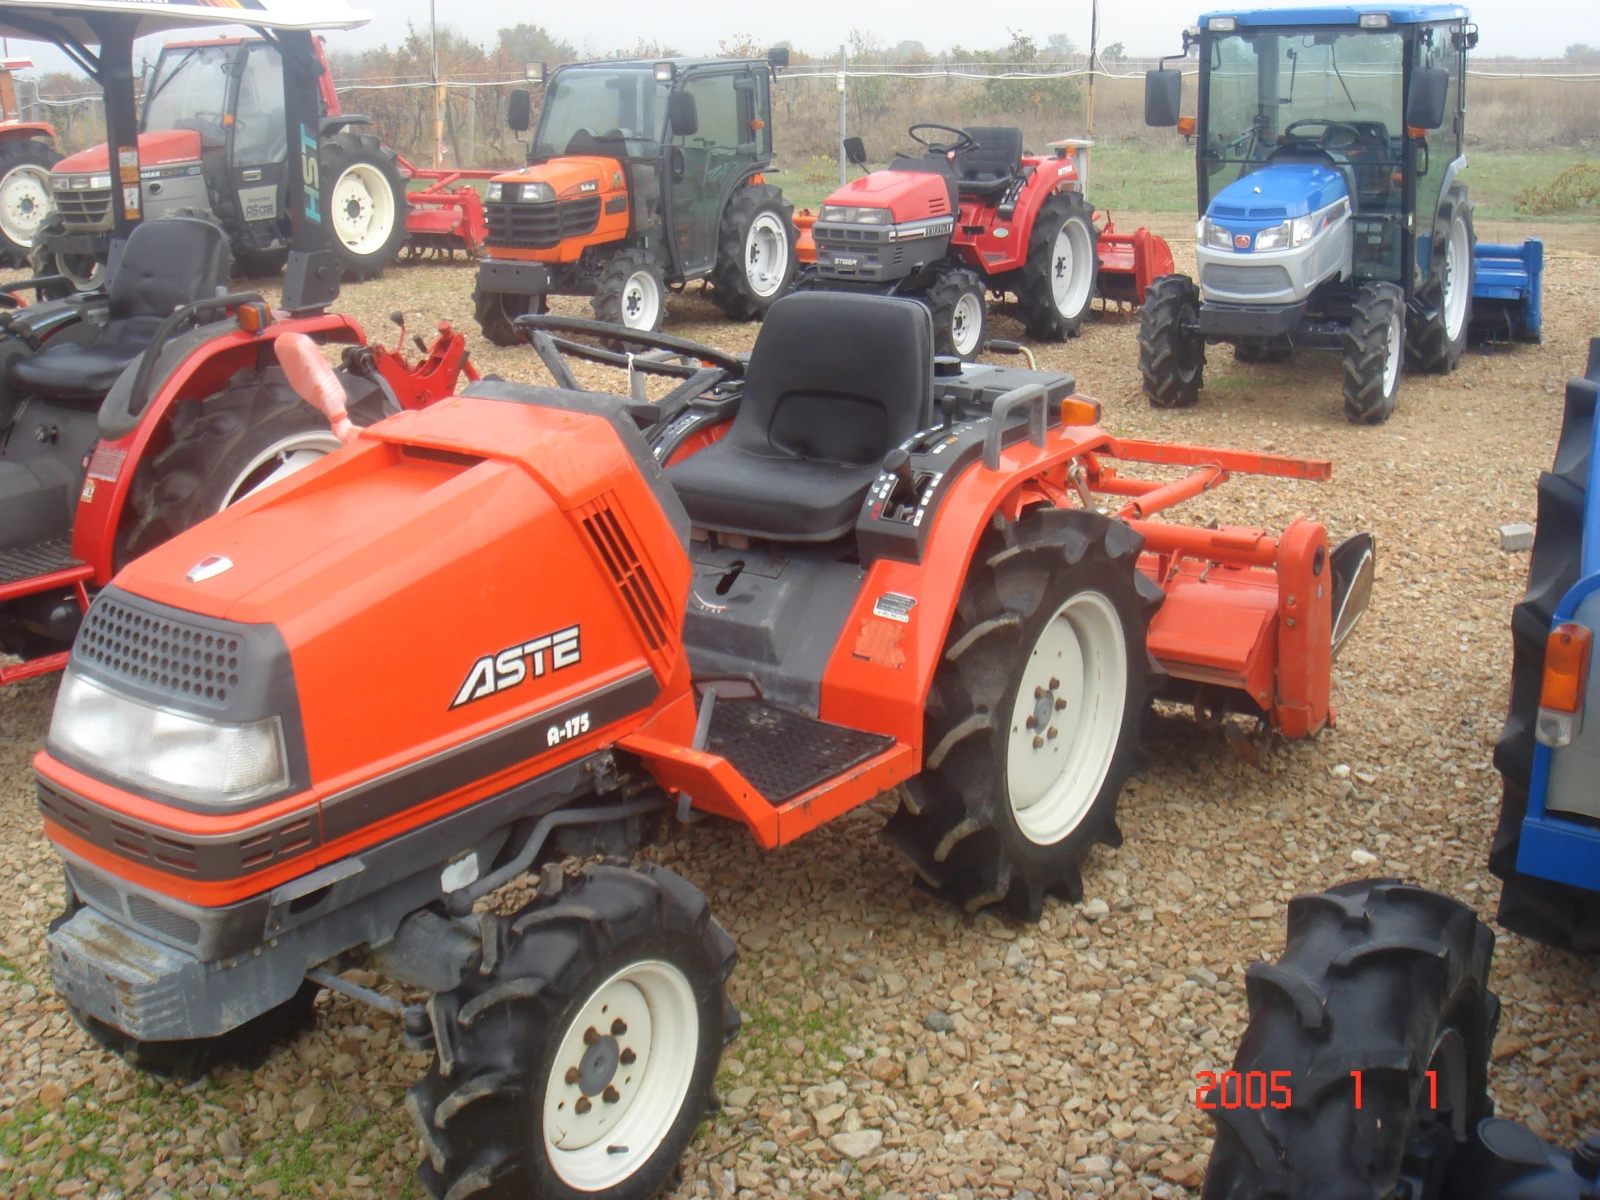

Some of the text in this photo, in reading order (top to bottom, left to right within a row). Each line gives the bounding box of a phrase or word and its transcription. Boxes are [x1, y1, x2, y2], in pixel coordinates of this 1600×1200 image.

[300, 122, 321, 223] HST
[924, 223, 951, 237] SHIBAURA
[834, 257, 858, 266] STIGER
[447, 623, 581, 711] ASTE
[546, 712, 590, 747] A-175
